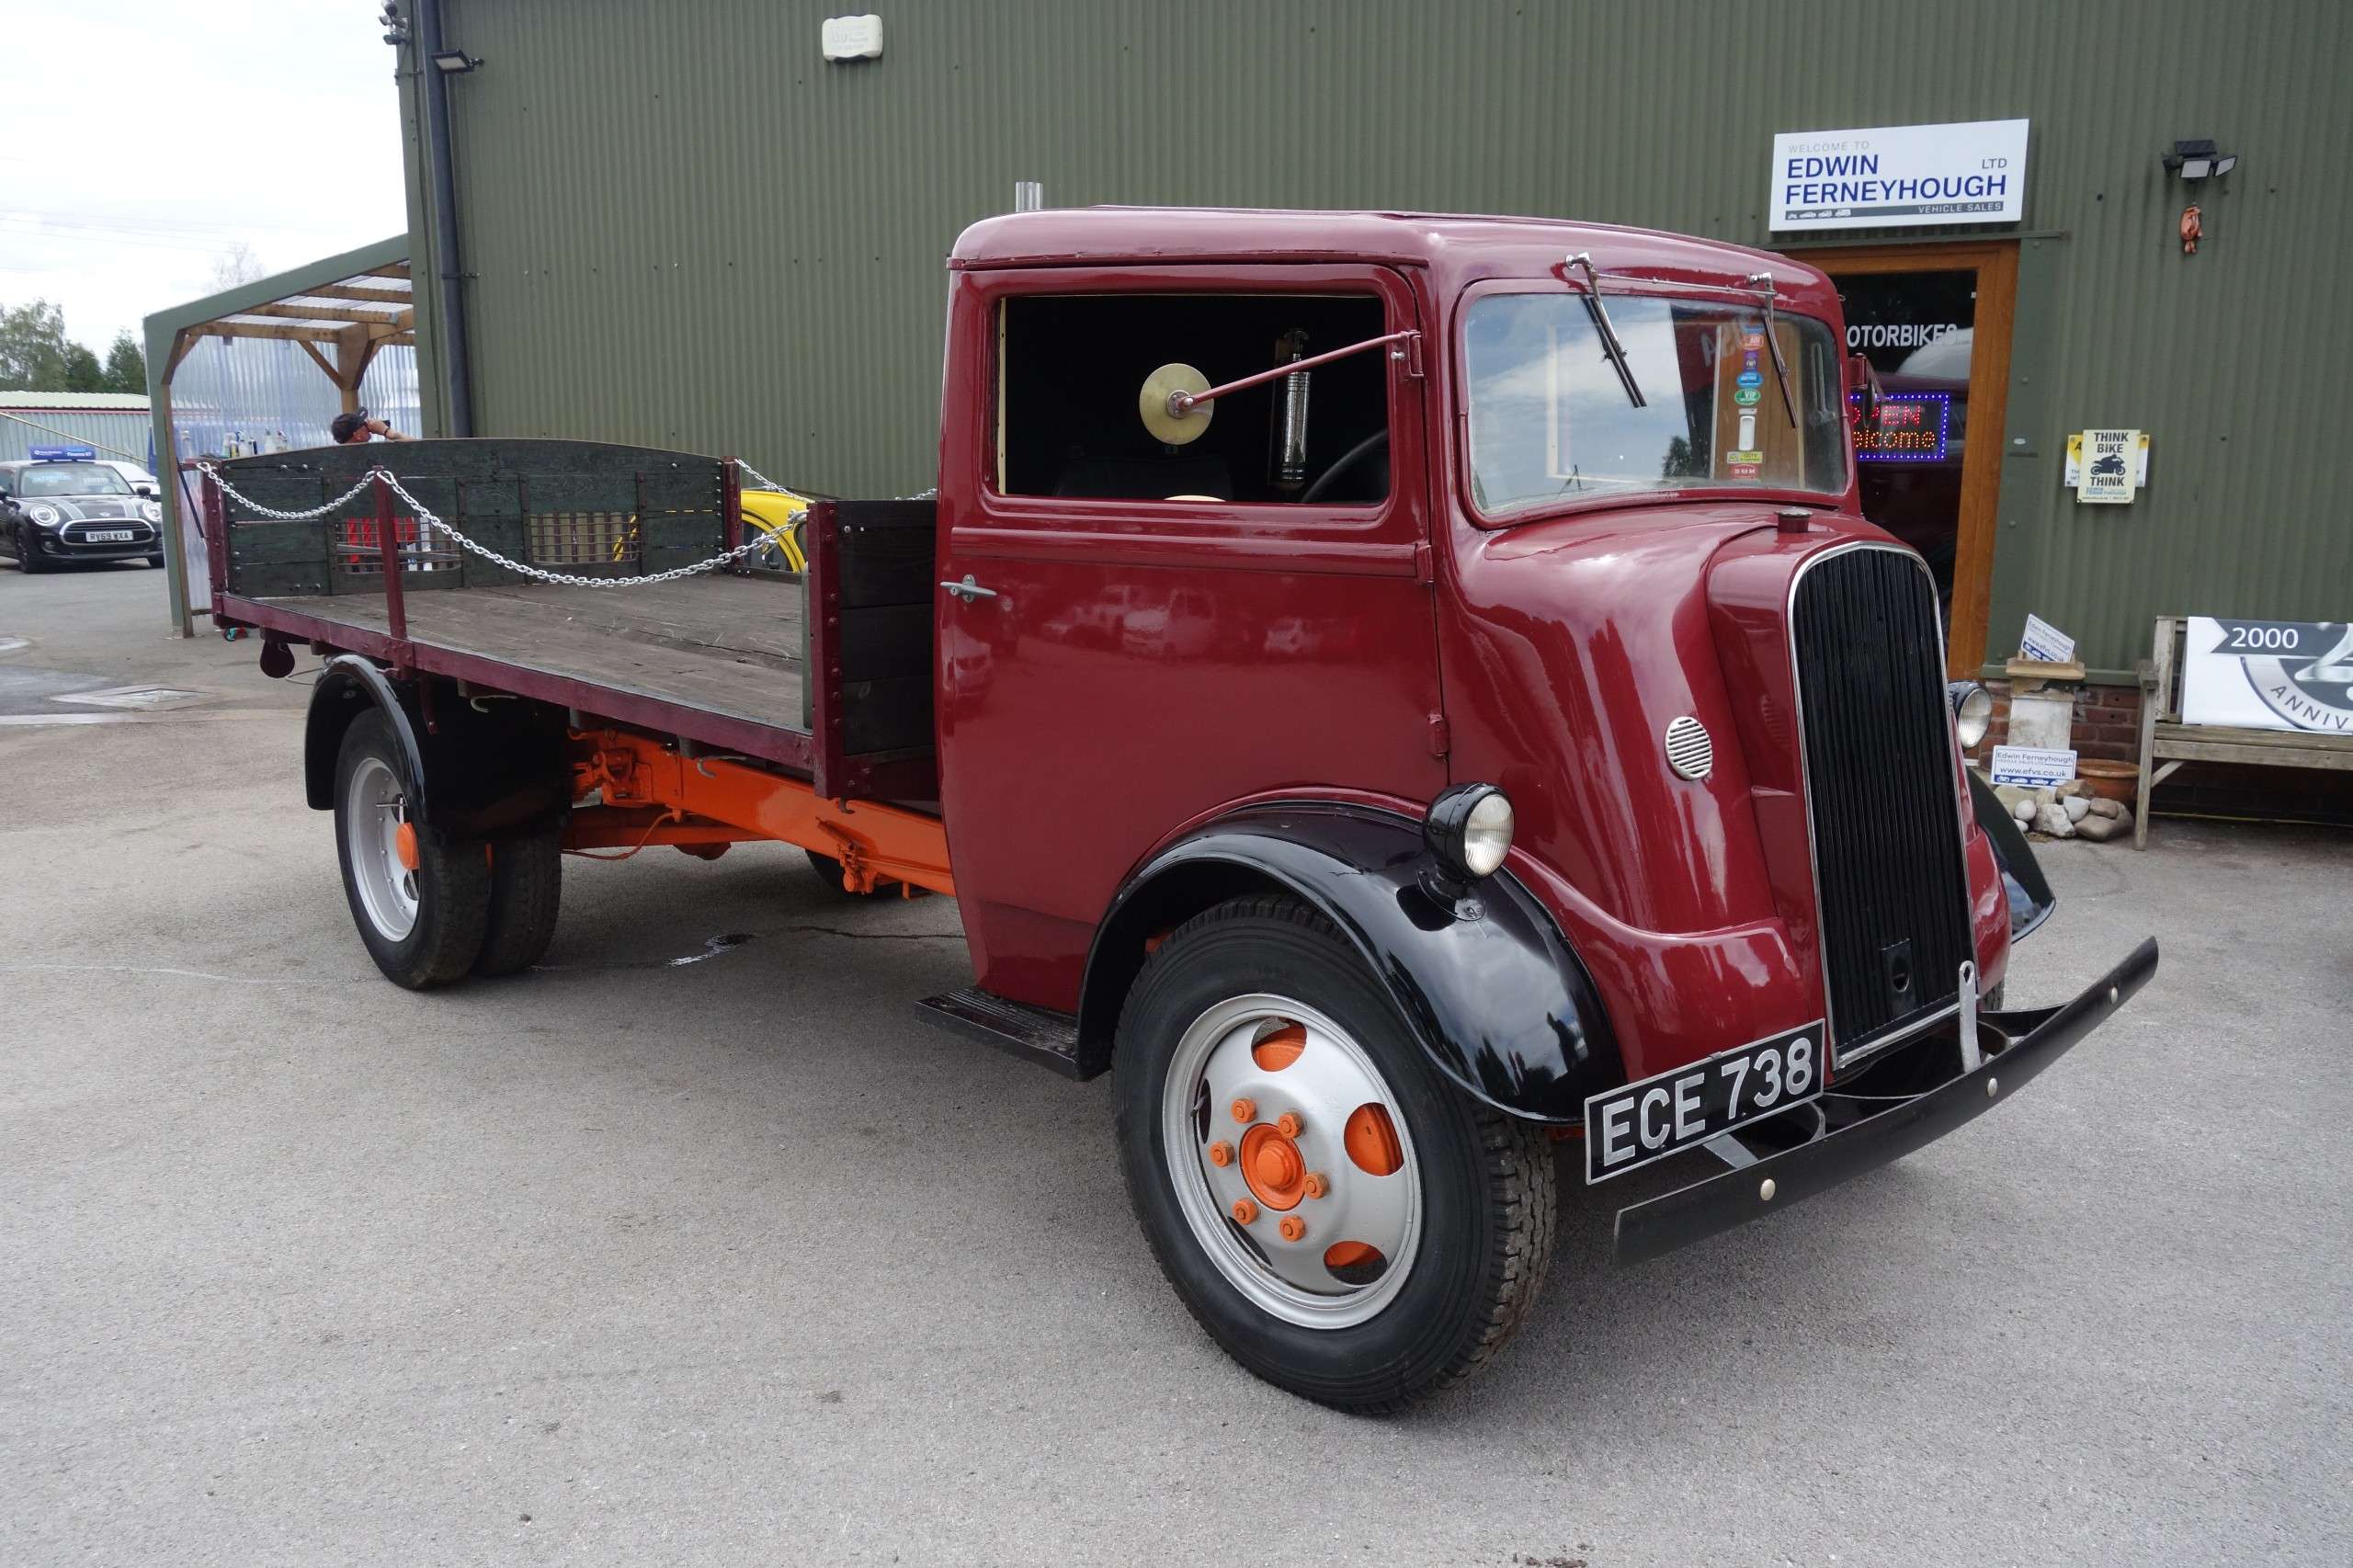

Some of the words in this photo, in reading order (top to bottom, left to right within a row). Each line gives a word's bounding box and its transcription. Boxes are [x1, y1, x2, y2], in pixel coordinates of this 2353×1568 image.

[1789, 142, 1847, 153] WELCOME
[1854, 141, 1870, 151] TO
[1787, 154, 1879, 179] EDWIN
[1982, 158, 2007, 170] LTD
[1785, 175, 2006, 204] FERNEYHOUGH
[1918, 204, 1964, 214] VEHICLE
[1967, 201, 2001, 212] SALES
[1844, 324, 1958, 348] OTORBIKES
[1853, 429, 1936, 449] elcome
[2094, 432, 2129, 442] THINK
[2097, 443, 2124, 453] BIKE
[2090, 476, 2124, 486] THINK
[2231, 627, 2299, 649] 2000
[1997, 752, 2020, 760] Edwin
[2022, 754, 2074, 764] Ferneyhough
[2000, 767, 2067, 777] www.efvs.co.uk
[1603, 1073, 1706, 1167] ECE
[1721, 1037, 1813, 1119] 738
